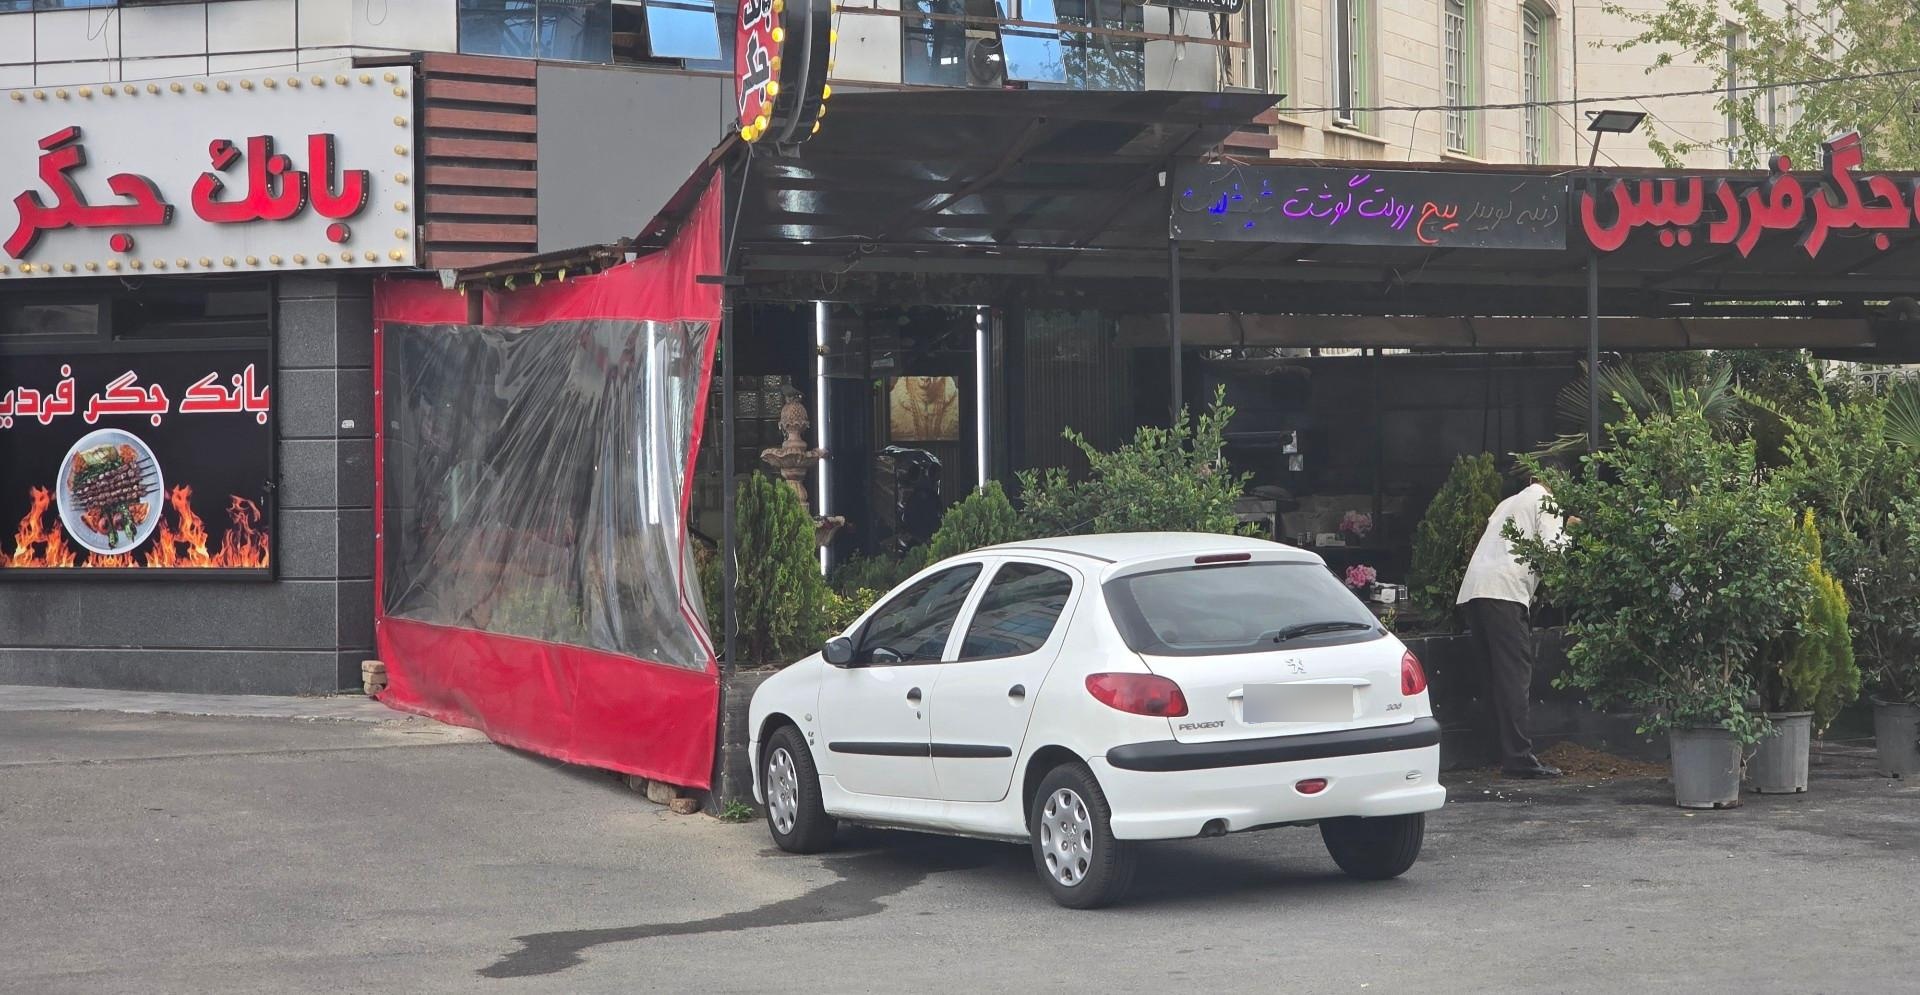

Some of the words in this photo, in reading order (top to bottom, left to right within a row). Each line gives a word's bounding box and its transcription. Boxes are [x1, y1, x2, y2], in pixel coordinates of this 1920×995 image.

[3, 126, 174, 259] جگر
[1283, 174, 1371, 226] گوشت
[1358, 187, 1415, 230] رولت
[1580, 155, 1804, 258] فردیس
[1803, 131, 1910, 259] جگر
[0, 364, 75, 429] فردی
[83, 370, 170, 427] جگر
[179, 363, 270, 425] بانک
[1178, 719, 1226, 731] PEUGEOT
